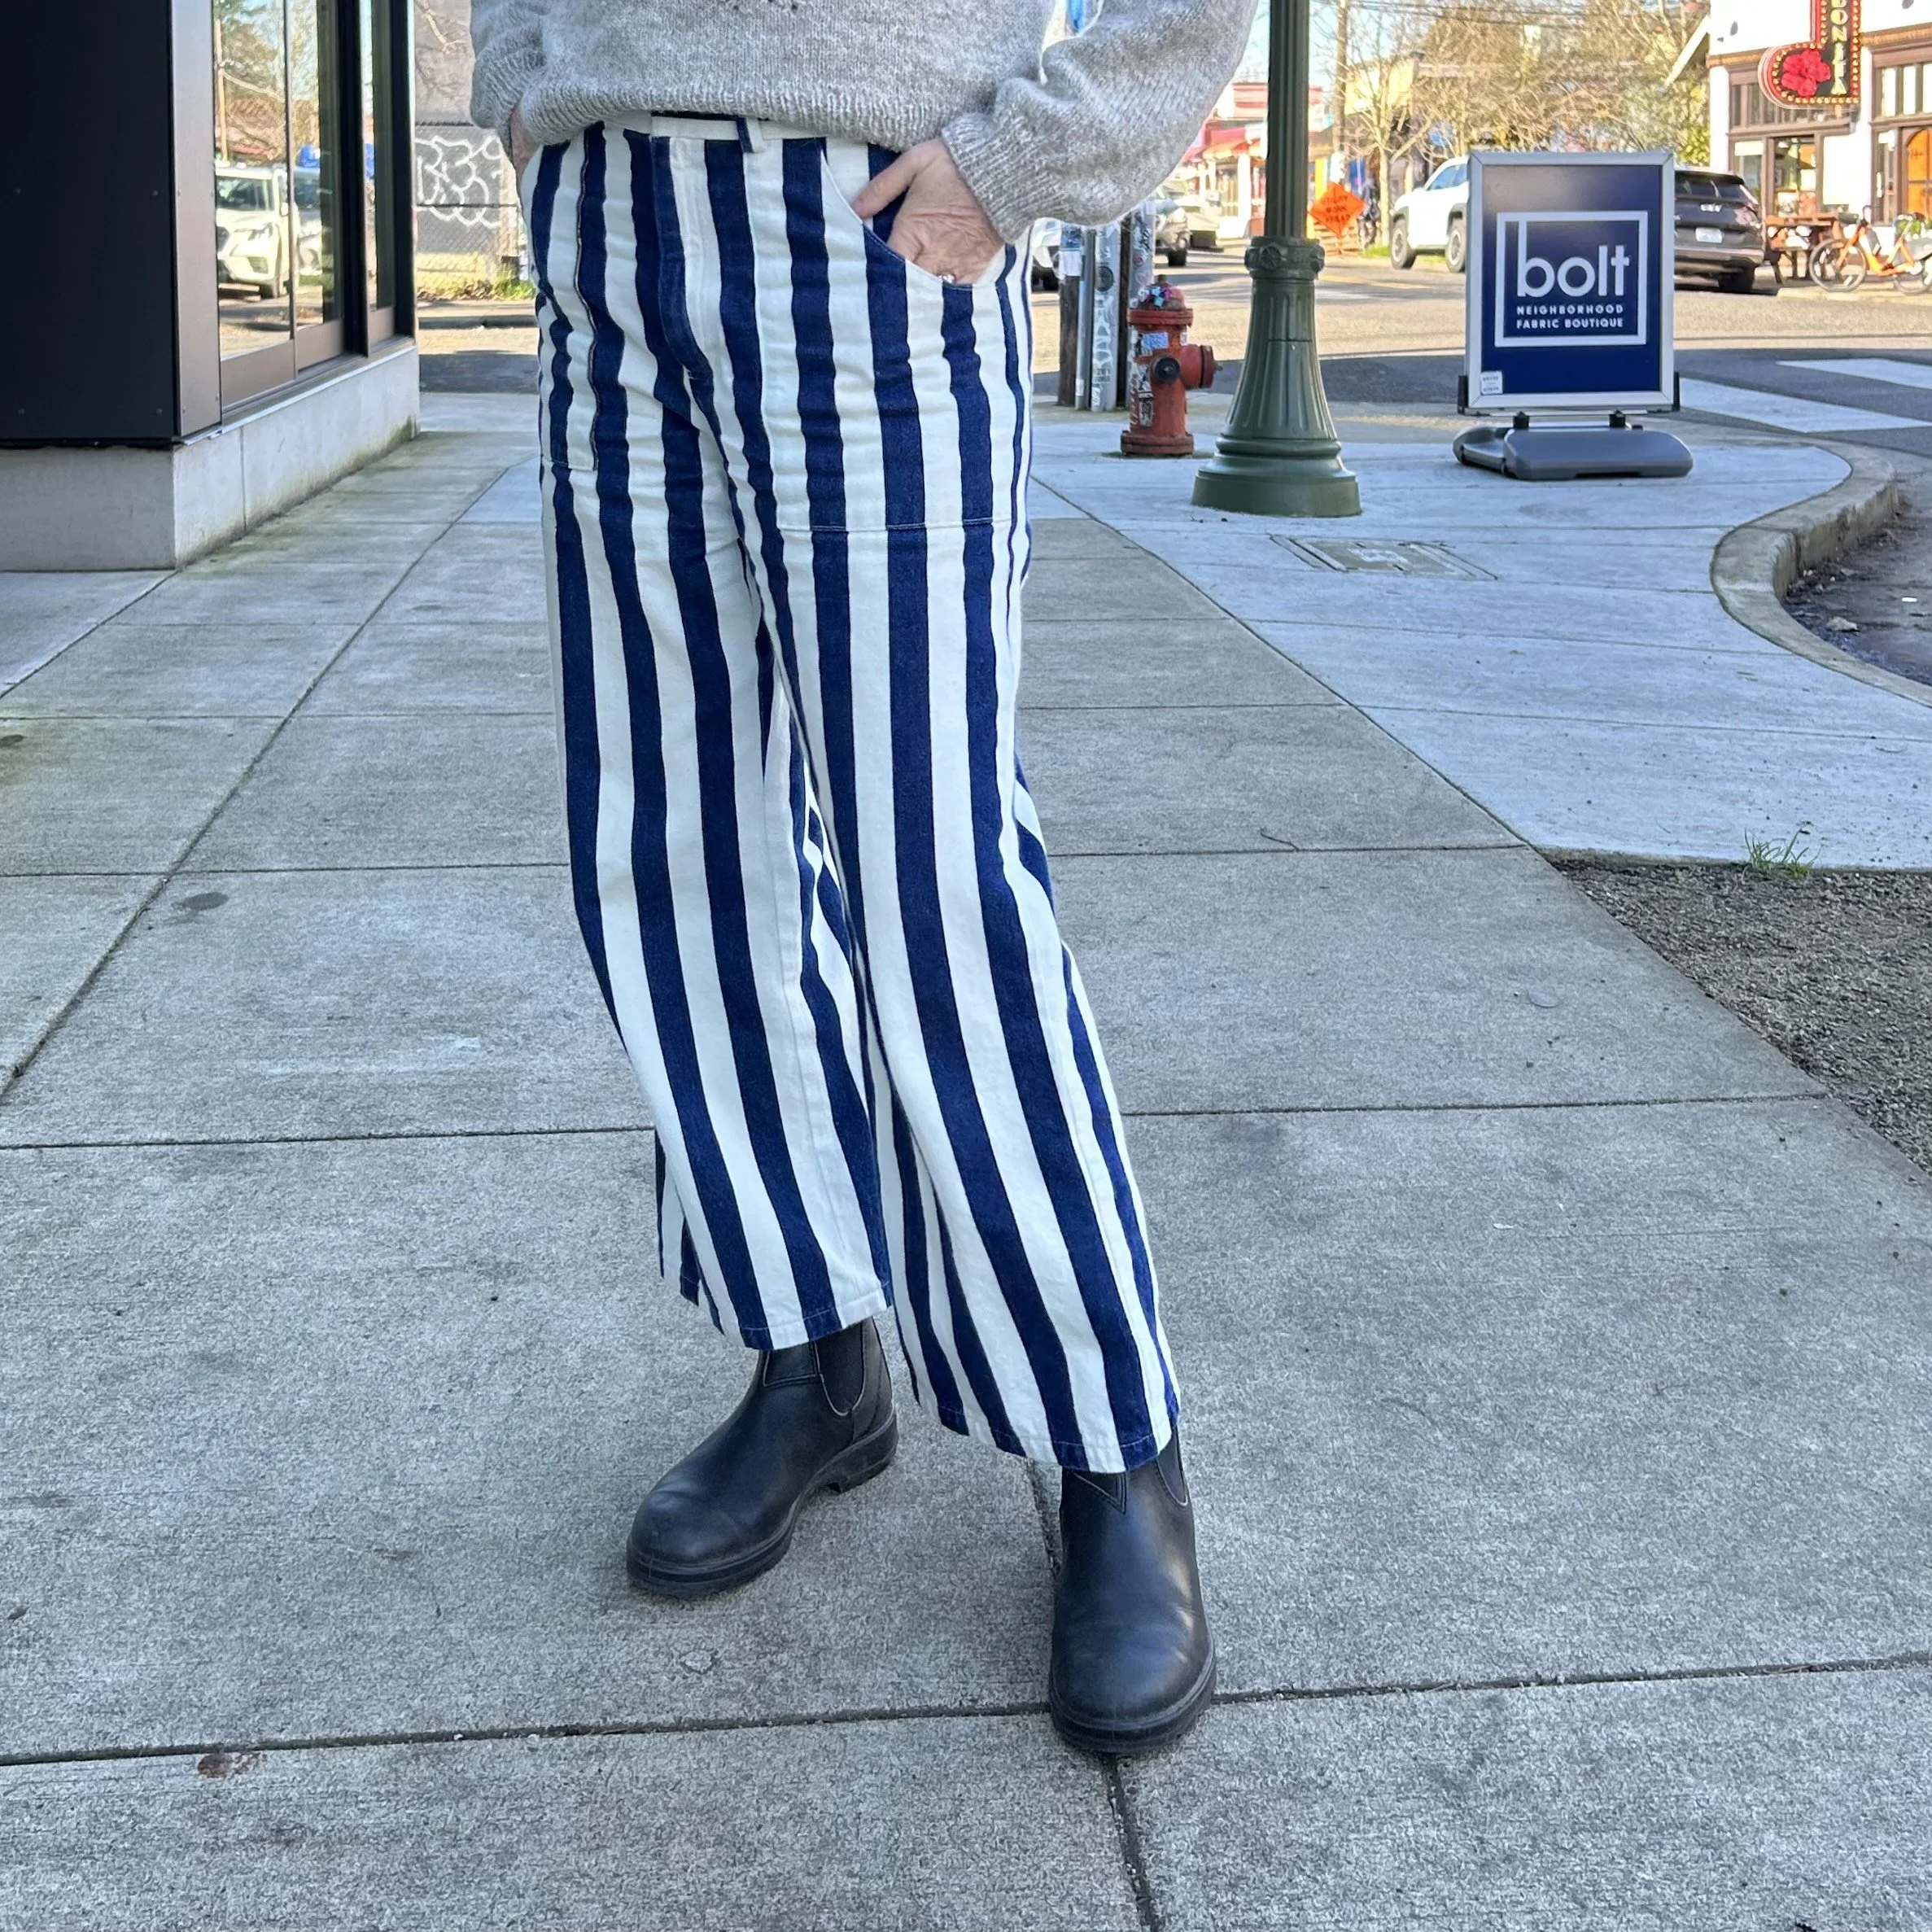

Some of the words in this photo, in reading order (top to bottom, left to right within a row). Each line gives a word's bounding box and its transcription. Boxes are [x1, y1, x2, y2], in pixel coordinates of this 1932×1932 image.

[1517, 221, 1630, 298] bolt
[1516, 304, 1624, 315] NEIGHBORHOOD
[1516, 319, 1559, 329] FABRIC
[1564, 317, 1624, 328] BOUTIQUE
